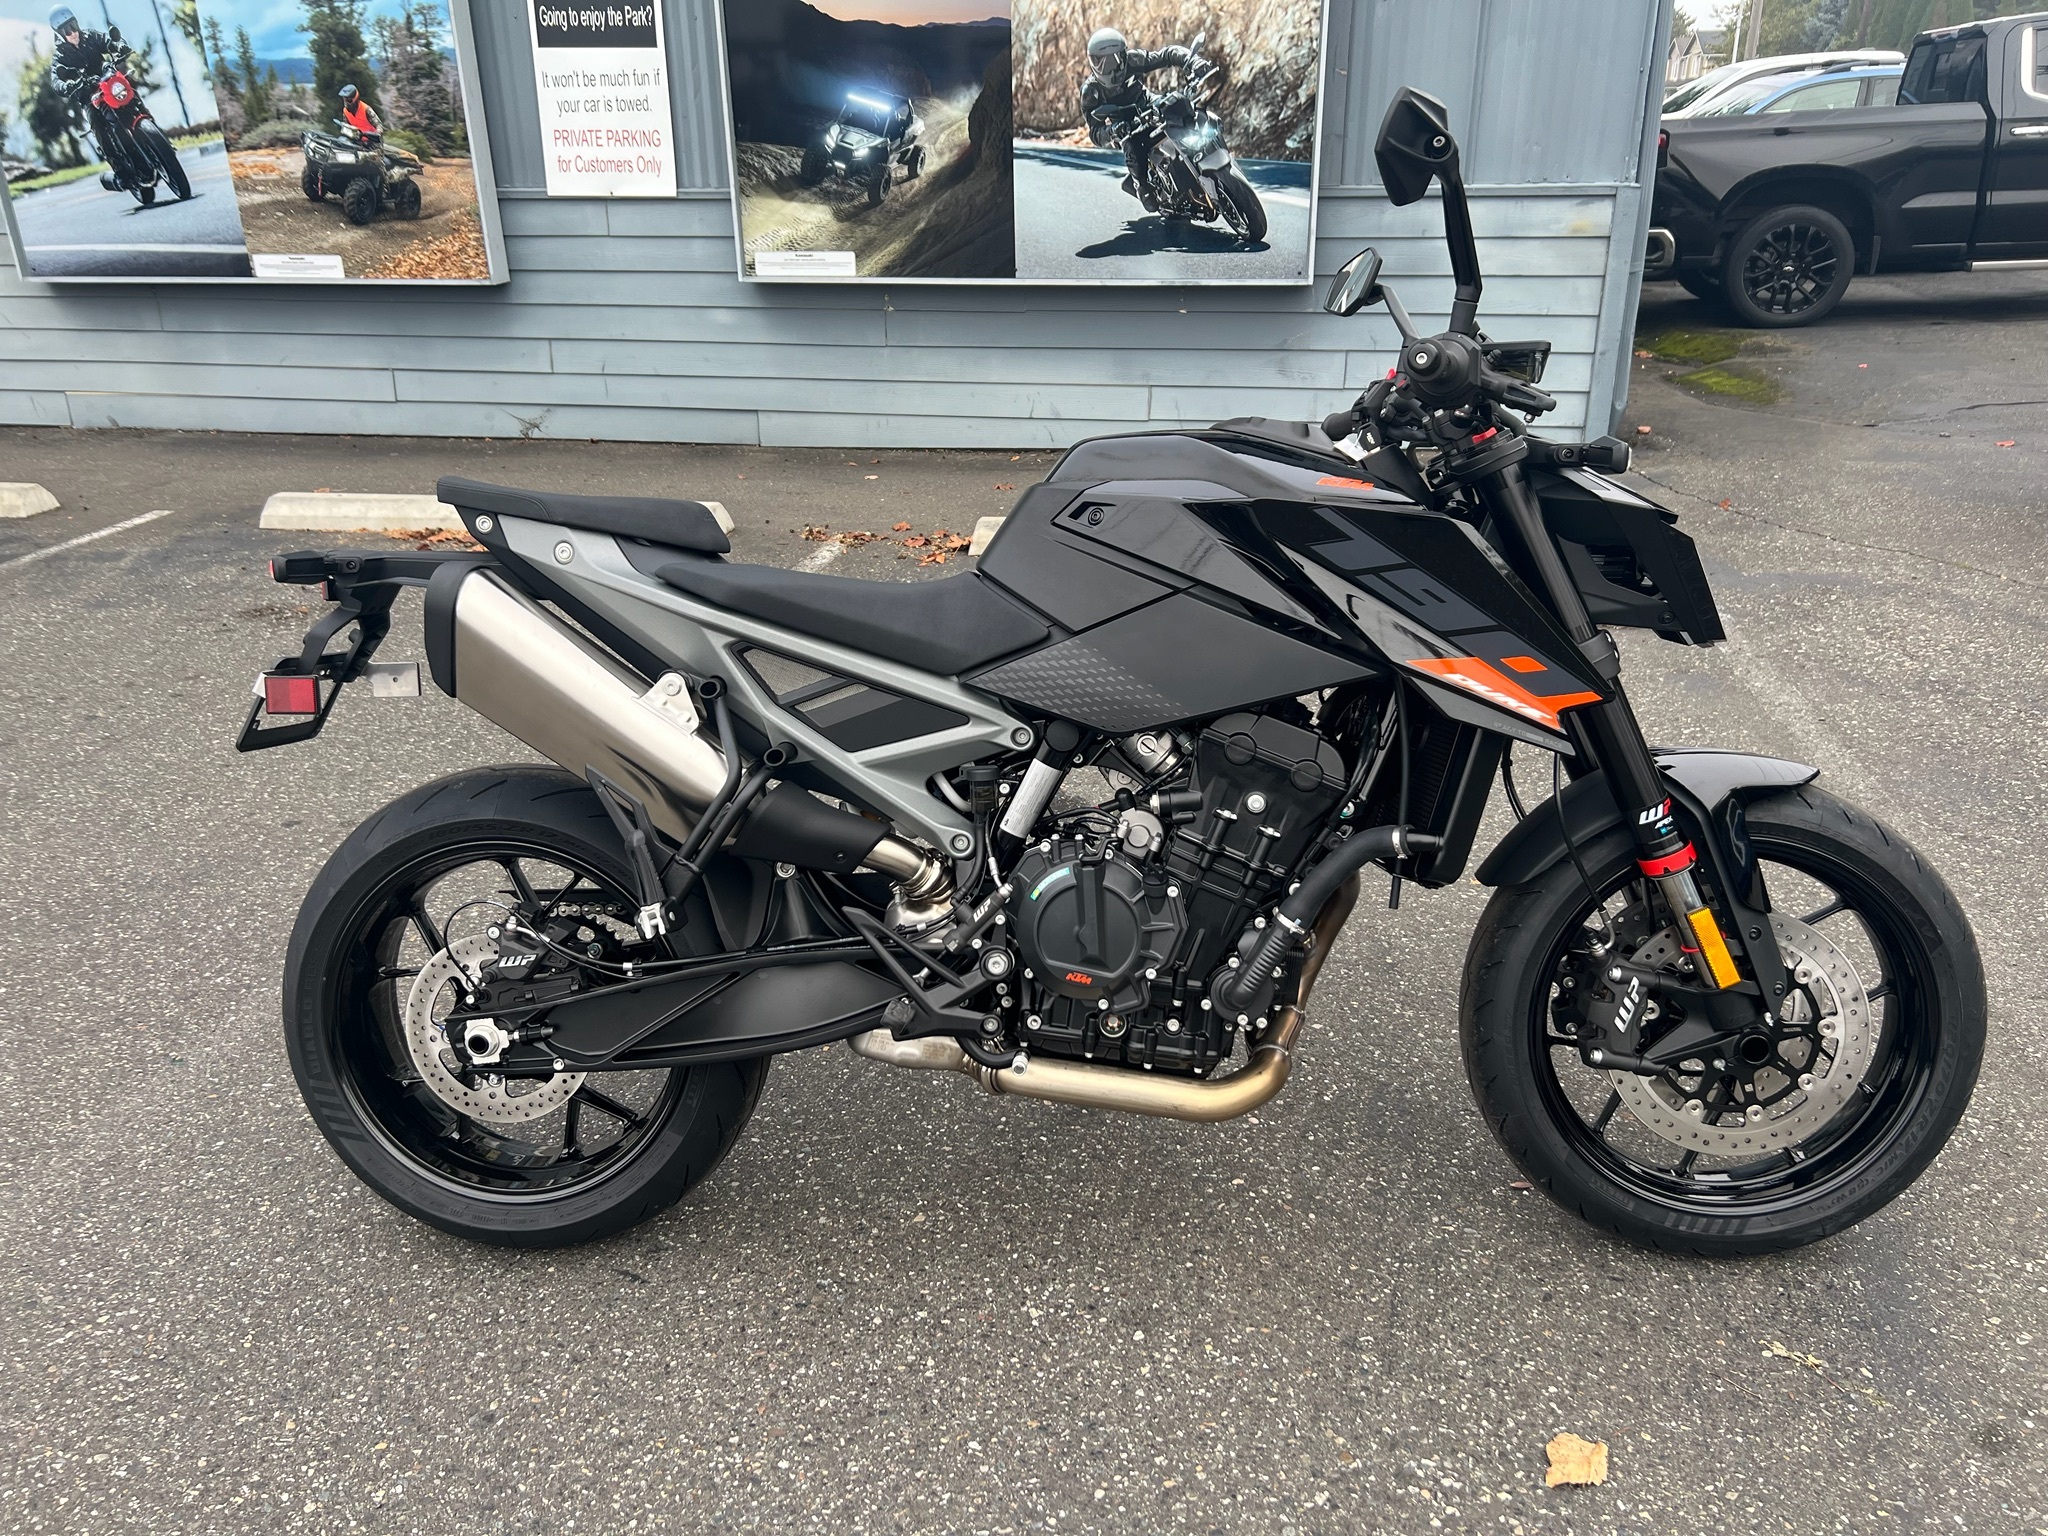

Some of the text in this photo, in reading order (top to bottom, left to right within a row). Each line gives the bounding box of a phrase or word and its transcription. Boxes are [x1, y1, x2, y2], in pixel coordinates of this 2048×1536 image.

[539, 5, 653, 32] Going to enjoy the Park?
[542, 68, 661, 88] It won't be much fun if
[556, 95, 653, 118] your car is towed.
[553, 129, 662, 148] PRIVATE PARKING
[557, 155, 662, 177] for Customers Only
[499, 953, 537, 968] WP
[1065, 971, 1093, 985] KTM
